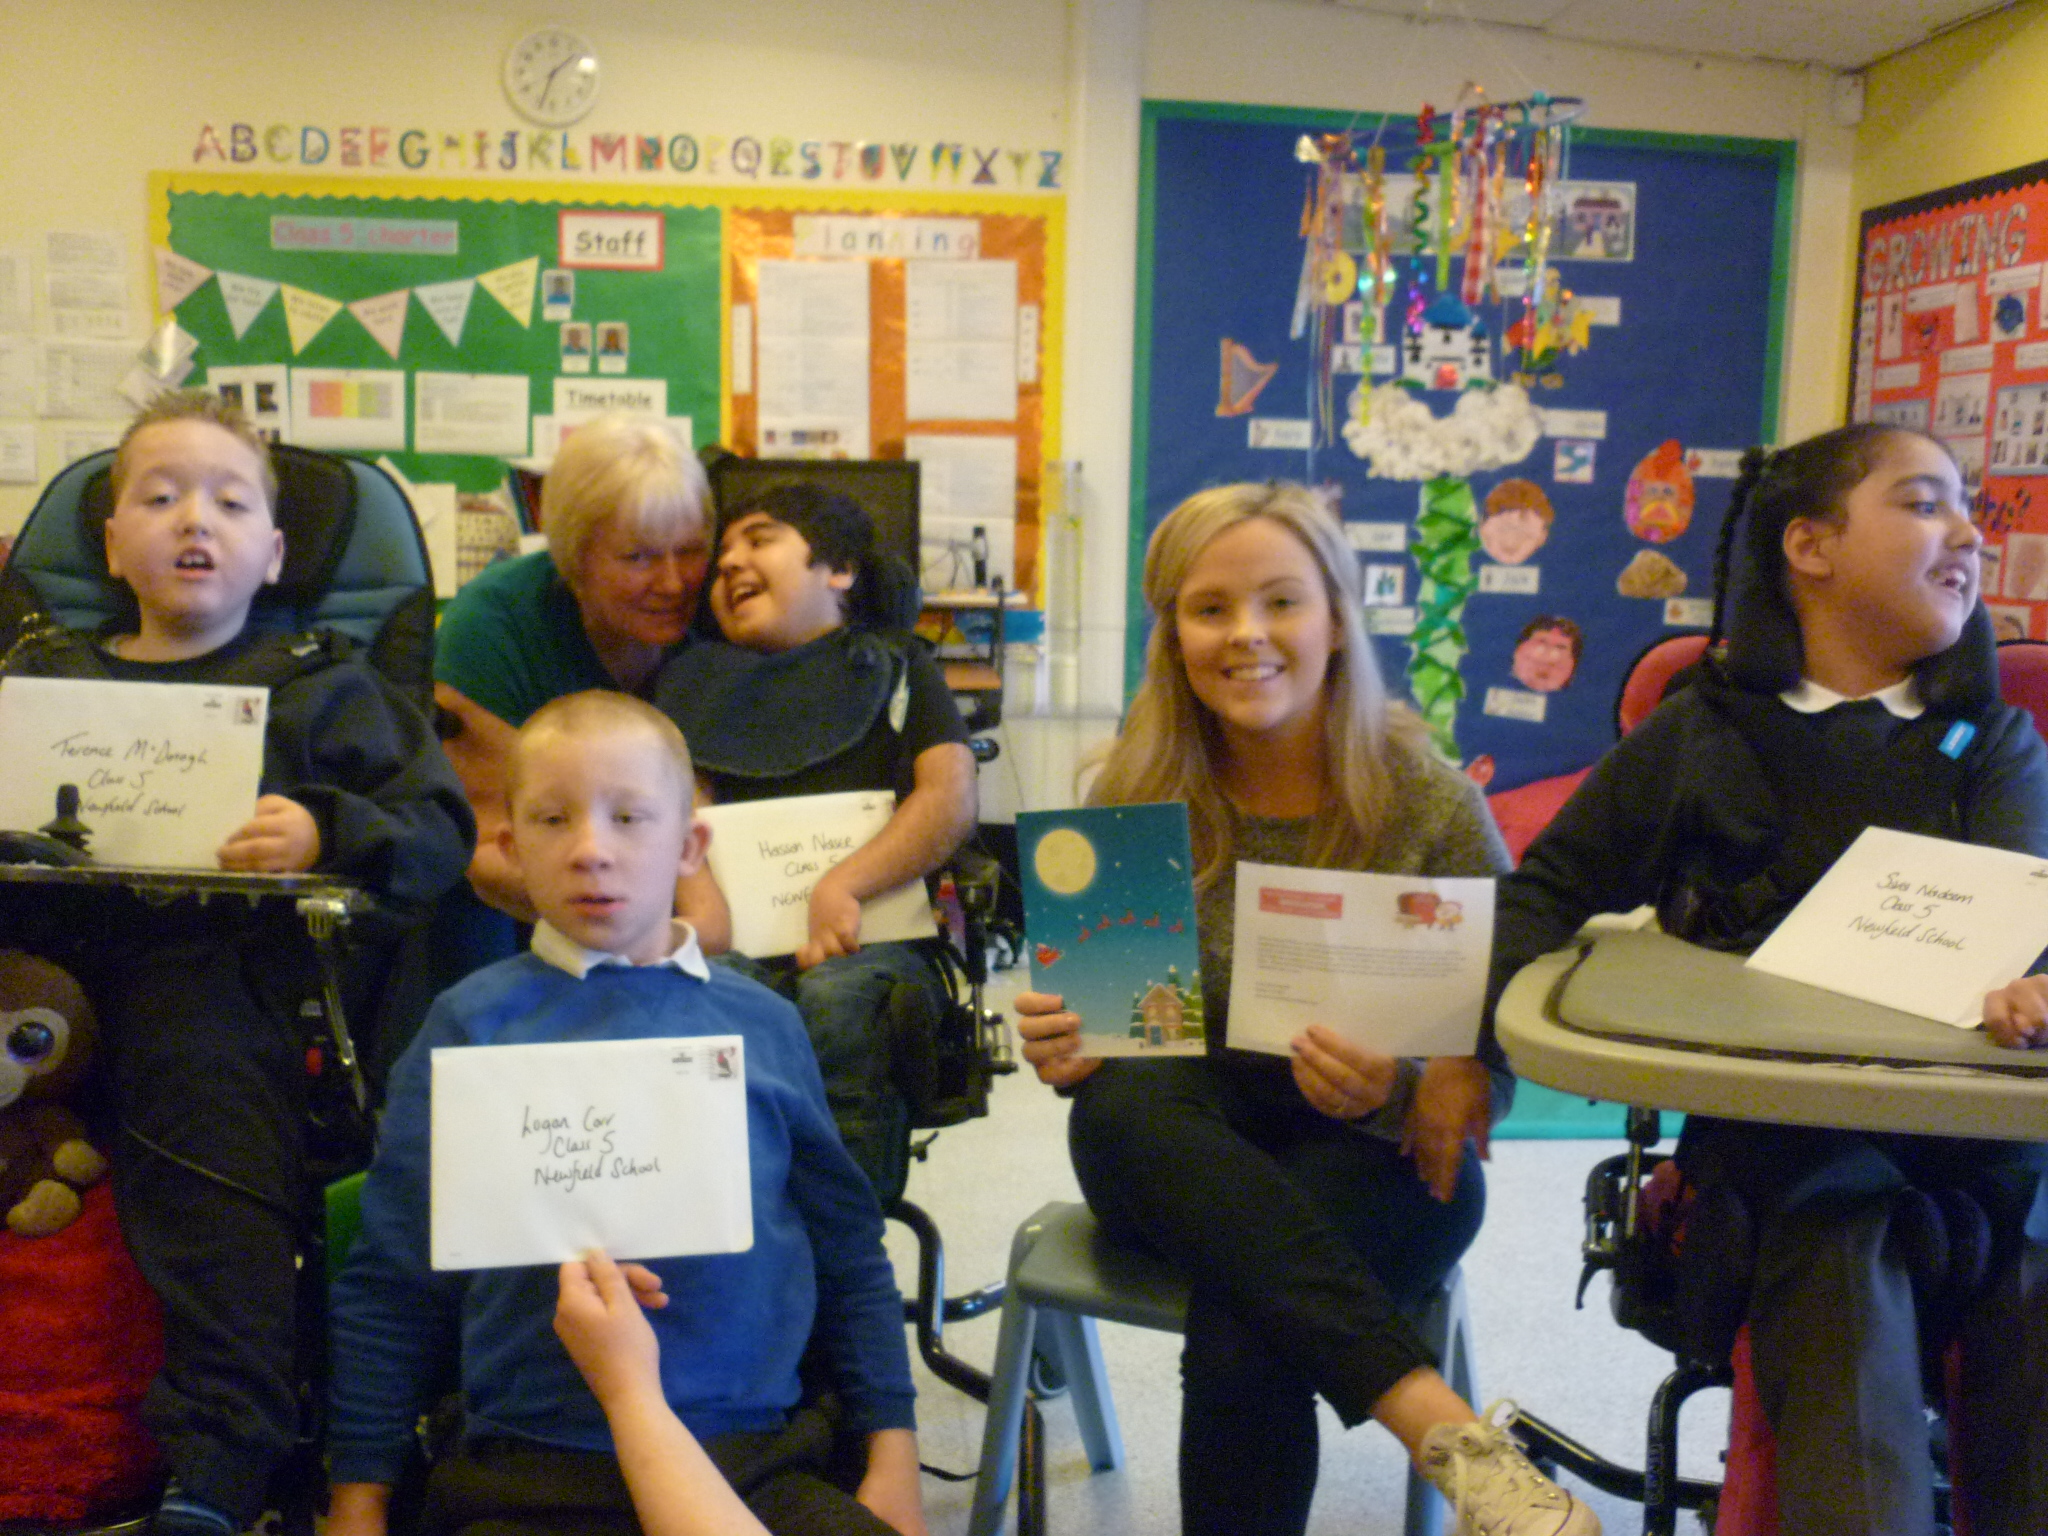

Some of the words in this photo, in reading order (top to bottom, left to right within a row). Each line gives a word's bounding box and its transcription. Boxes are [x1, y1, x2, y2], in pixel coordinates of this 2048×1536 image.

[368, 225, 456, 246] charter
[573, 229, 648, 254] Staff
[806, 223, 977, 259] laning
[1866, 203, 2029, 292] GROWING
[564, 389, 653, 408] Timetable
[130, 770, 154, 789] 5
[1912, 904, 1941, 919] 5
[1917, 927, 1966, 951] School
[520, 1105, 571, 1154] Logan
[553, 1135, 591, 1159] Class
[600, 1130, 616, 1154] 5
[533, 1154, 605, 1193] Newfield
[610, 1156, 662, 1180] School
